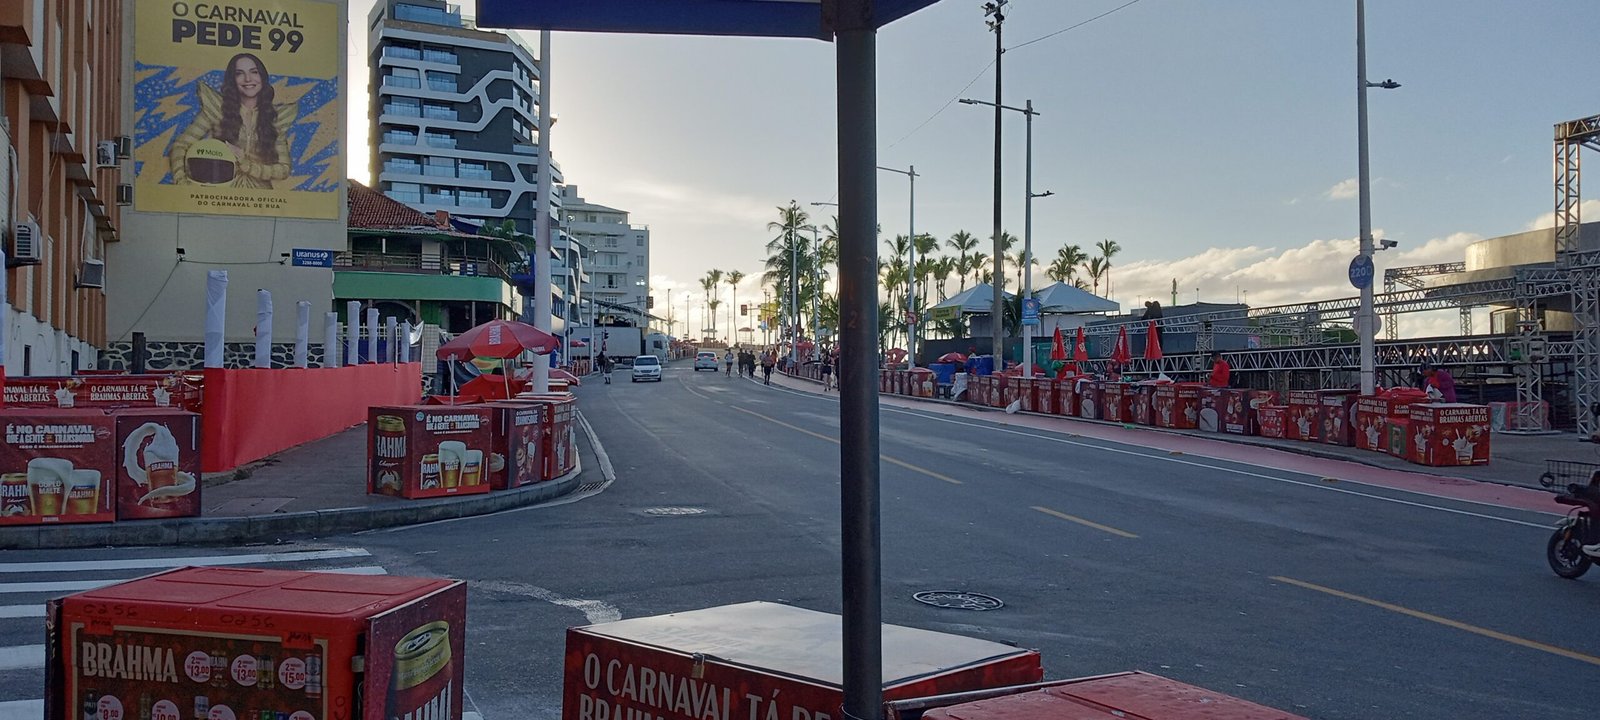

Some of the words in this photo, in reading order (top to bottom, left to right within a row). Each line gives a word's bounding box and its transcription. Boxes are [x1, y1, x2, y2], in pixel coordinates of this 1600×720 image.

[172, 1, 189, 17] O
[194, 3, 304, 28] CARNAVAL
[172, 18, 262, 50] PEDE
[268, 27, 304, 53] 99
[190, 193, 255, 202] PATROCINADORA
[97, 385, 129, 393] CARNAVAL
[19, 393, 50, 402] ABERTAS
[90, 393, 121, 401] BRAHMAS
[121, 392, 149, 401] ABERTAS
[443, 414, 480, 422] CARNAVAL
[1439, 415, 1465, 423] BRAHMAS
[1464, 414, 1488, 422] ABERTAS
[6, 423, 14, 434] É
[16, 425, 33, 434] NO
[38, 425, 95, 434] CARNAVAL
[82, 641, 179, 684] BRAHMA
[583, 653, 600, 689] O
[606, 658, 731, 720] CARNAVAL
